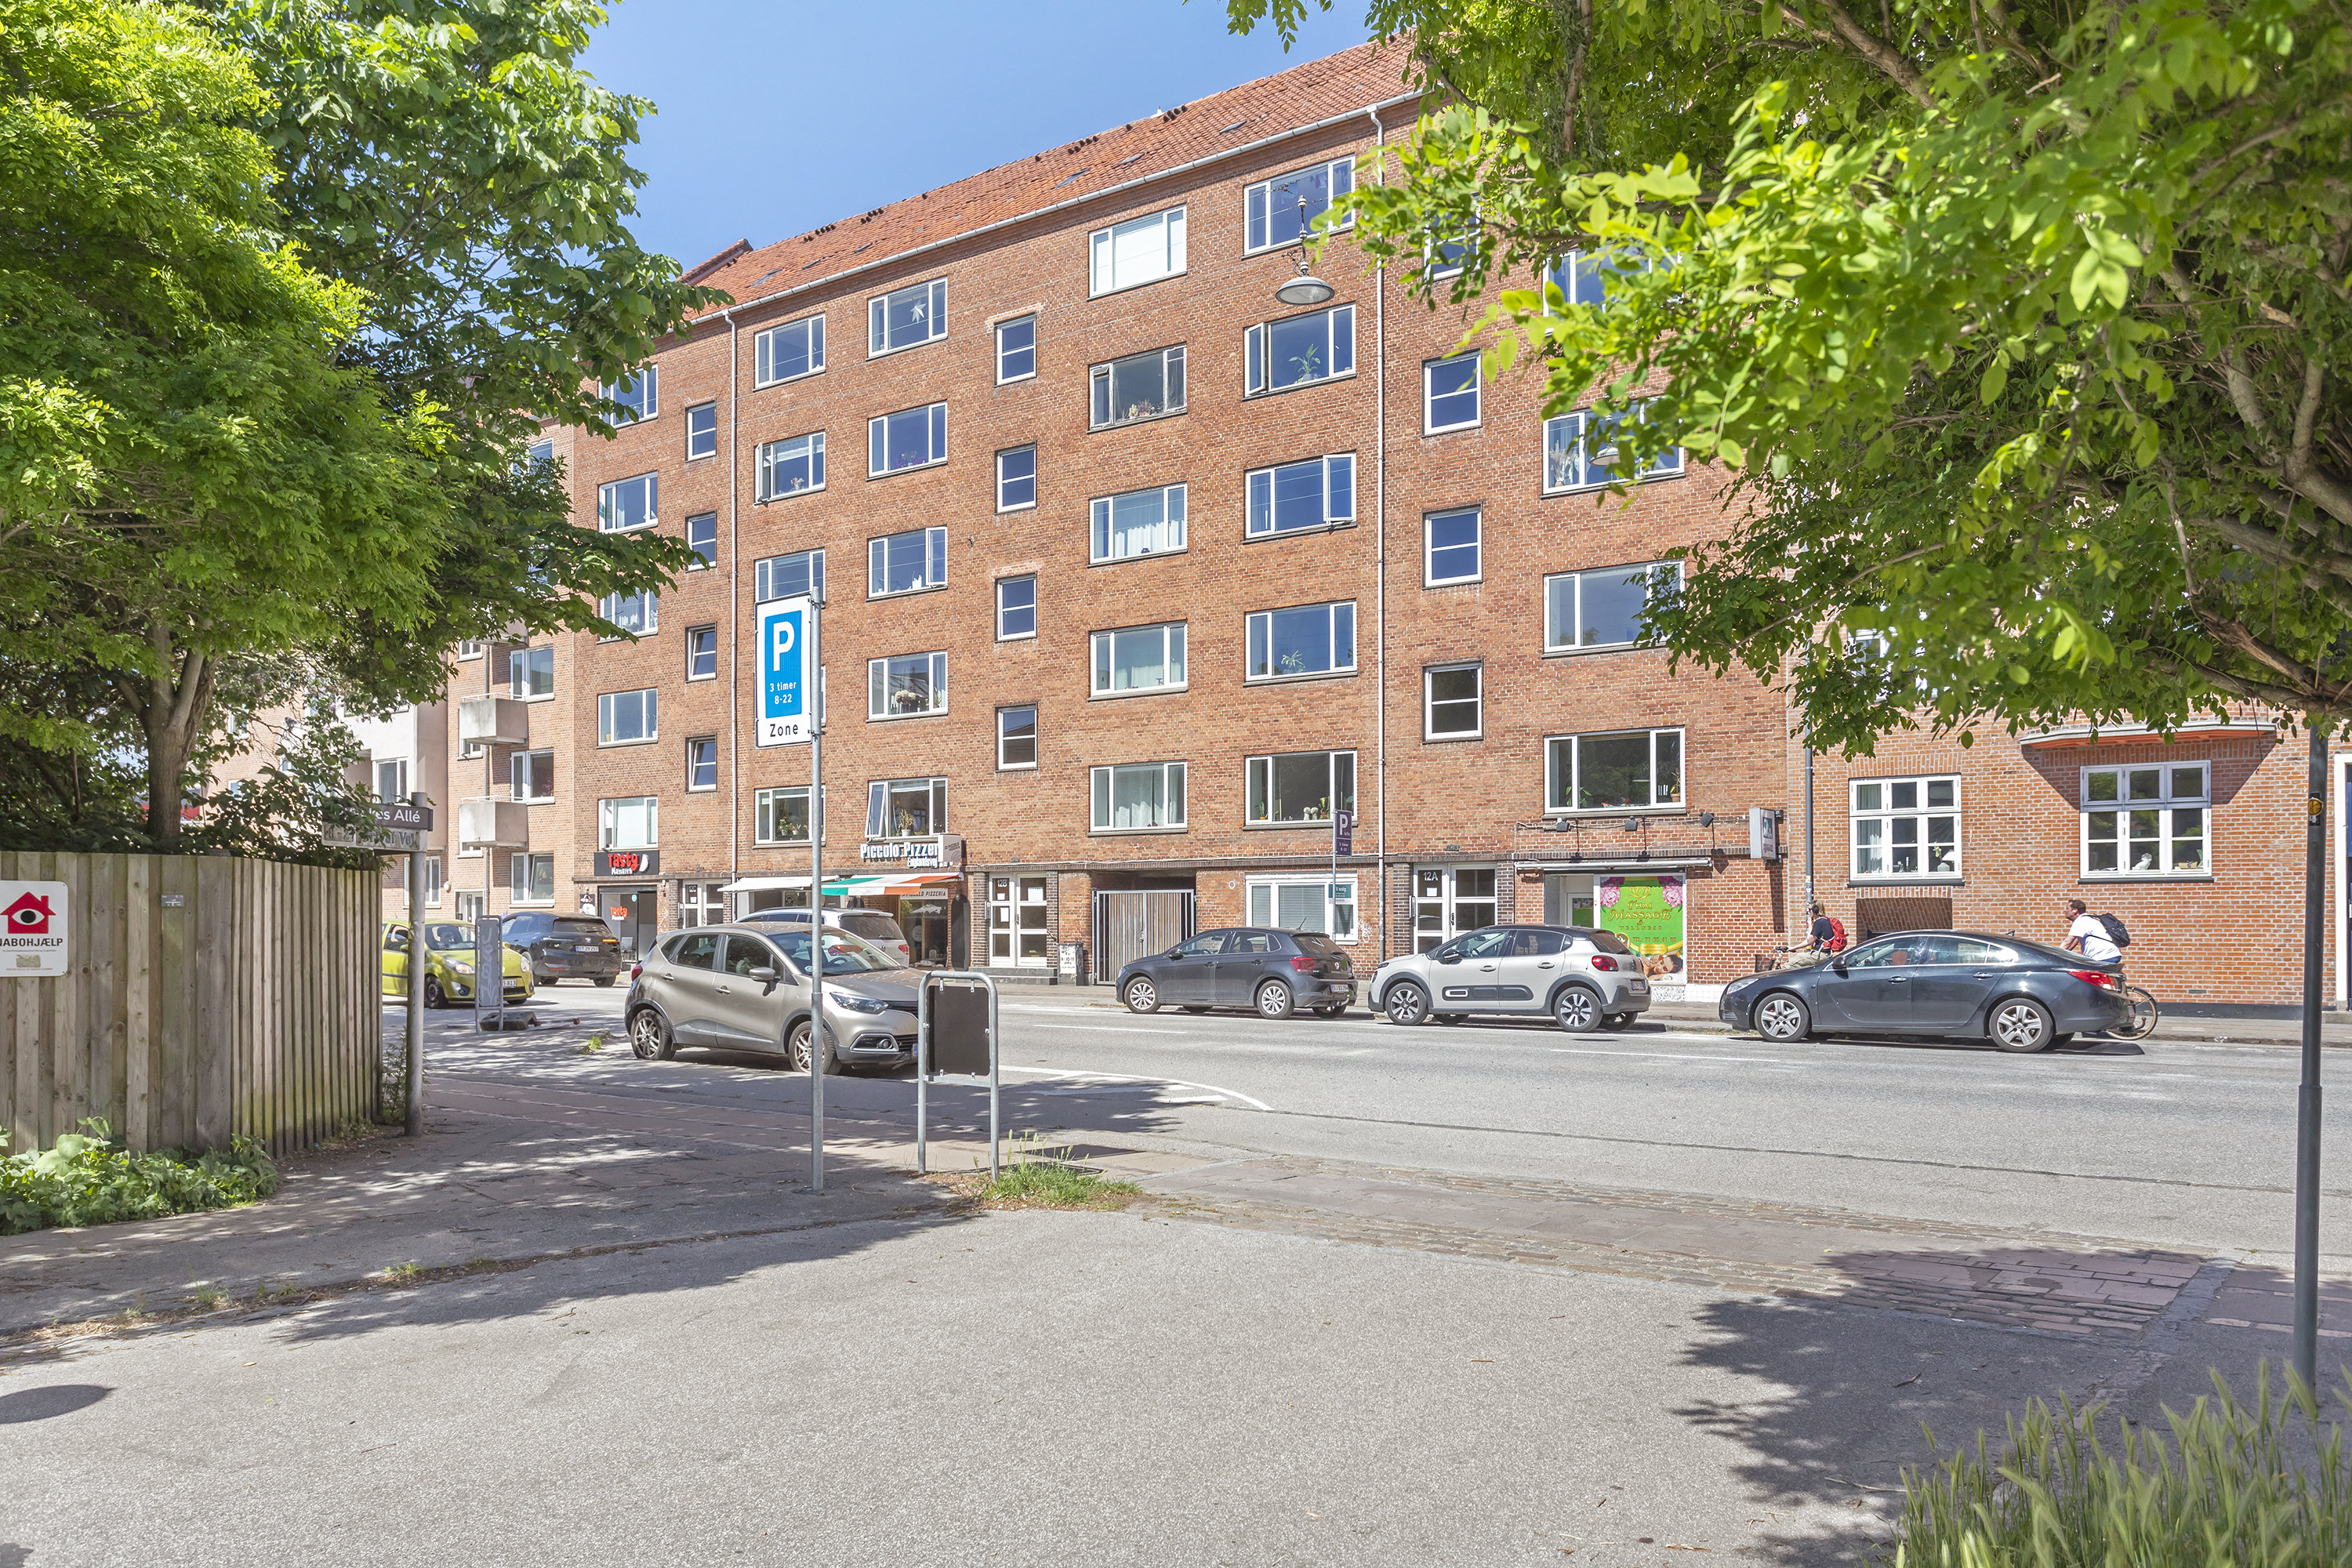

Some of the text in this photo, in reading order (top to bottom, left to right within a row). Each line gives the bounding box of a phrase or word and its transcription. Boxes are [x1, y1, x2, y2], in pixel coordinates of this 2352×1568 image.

[773, 621, 795, 672] P
[769, 681, 797, 692] 3 timer
[774, 694, 793, 704] 8-22
[770, 724, 799, 737] Zone
[394, 809, 421, 822] Allé
[1339, 814, 1348, 836] P
[861, 842, 938, 859] Piccolo Pizzer
[608, 851, 638, 871] Tasty
[1423, 871, 1439, 881] 12A
[1607, 908, 1673, 921] MASSAGE
